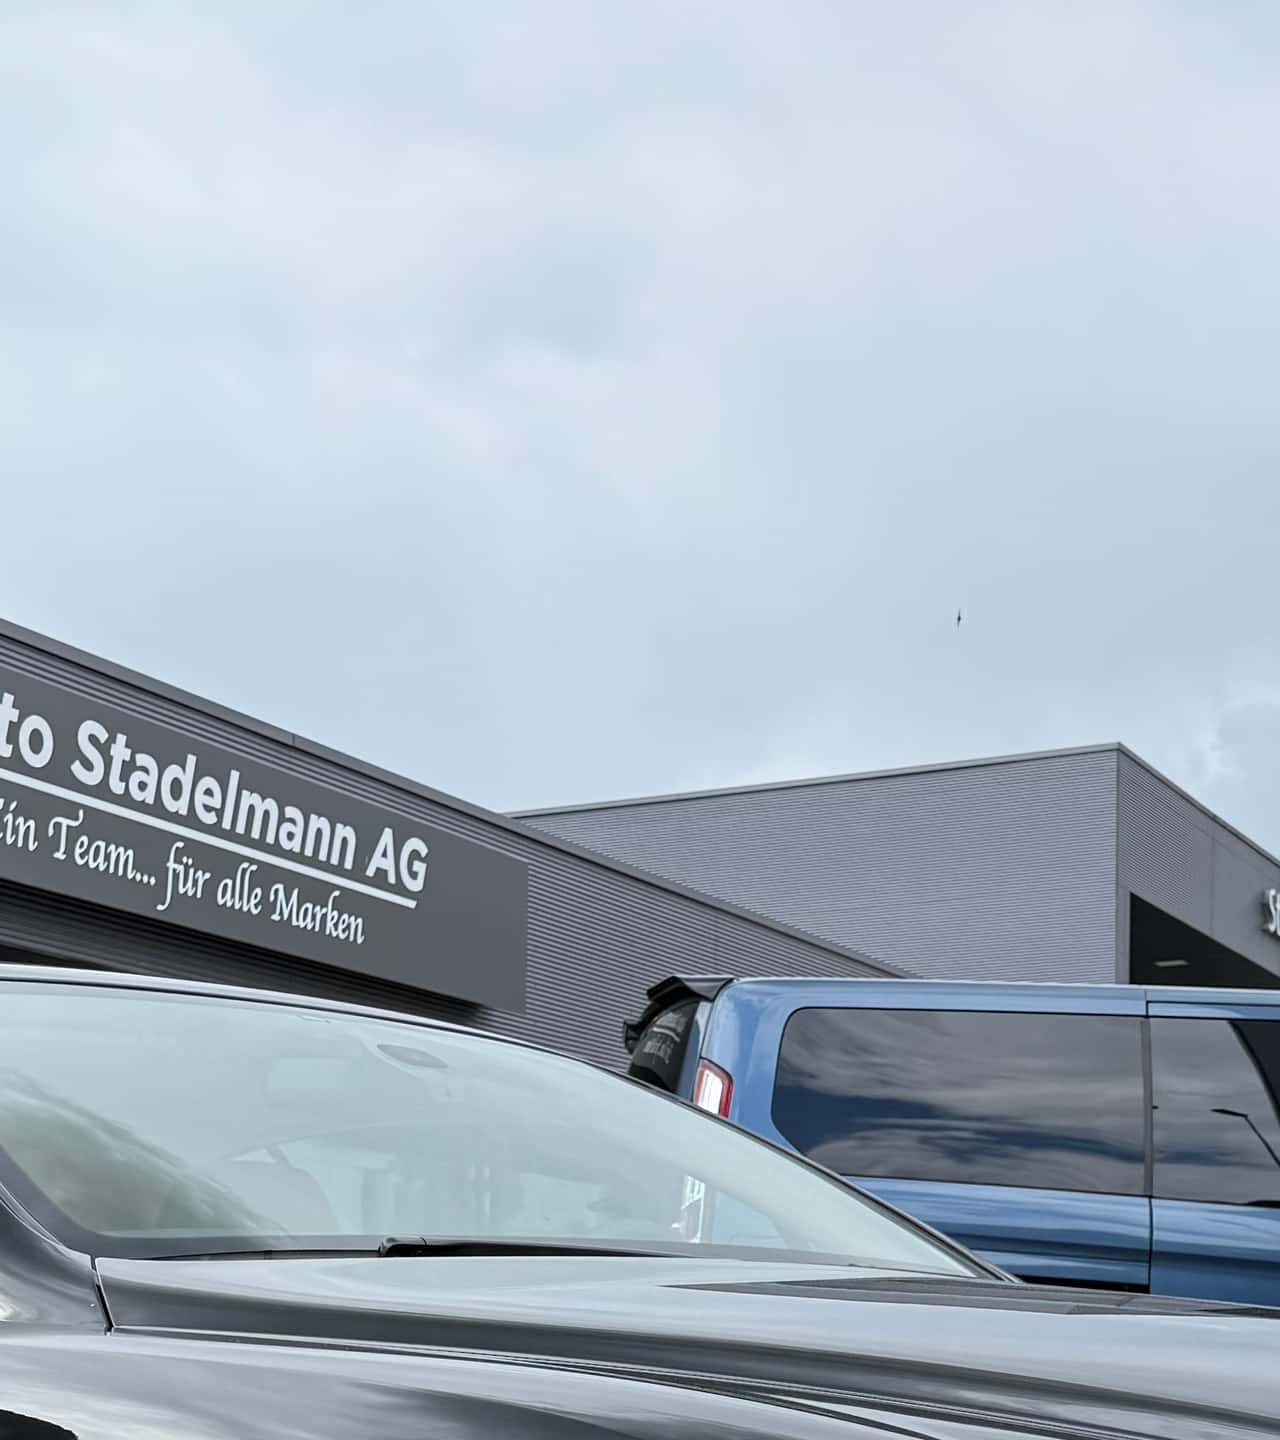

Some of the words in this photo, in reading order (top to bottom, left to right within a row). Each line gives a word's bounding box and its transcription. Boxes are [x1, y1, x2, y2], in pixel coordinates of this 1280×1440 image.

[70, 719, 357, 871] Stadelmann
[366, 825, 428, 892] AG
[155, 842, 211, 910] für
[217, 862, 262, 914] alle
[269, 882, 365, 945] Marken
